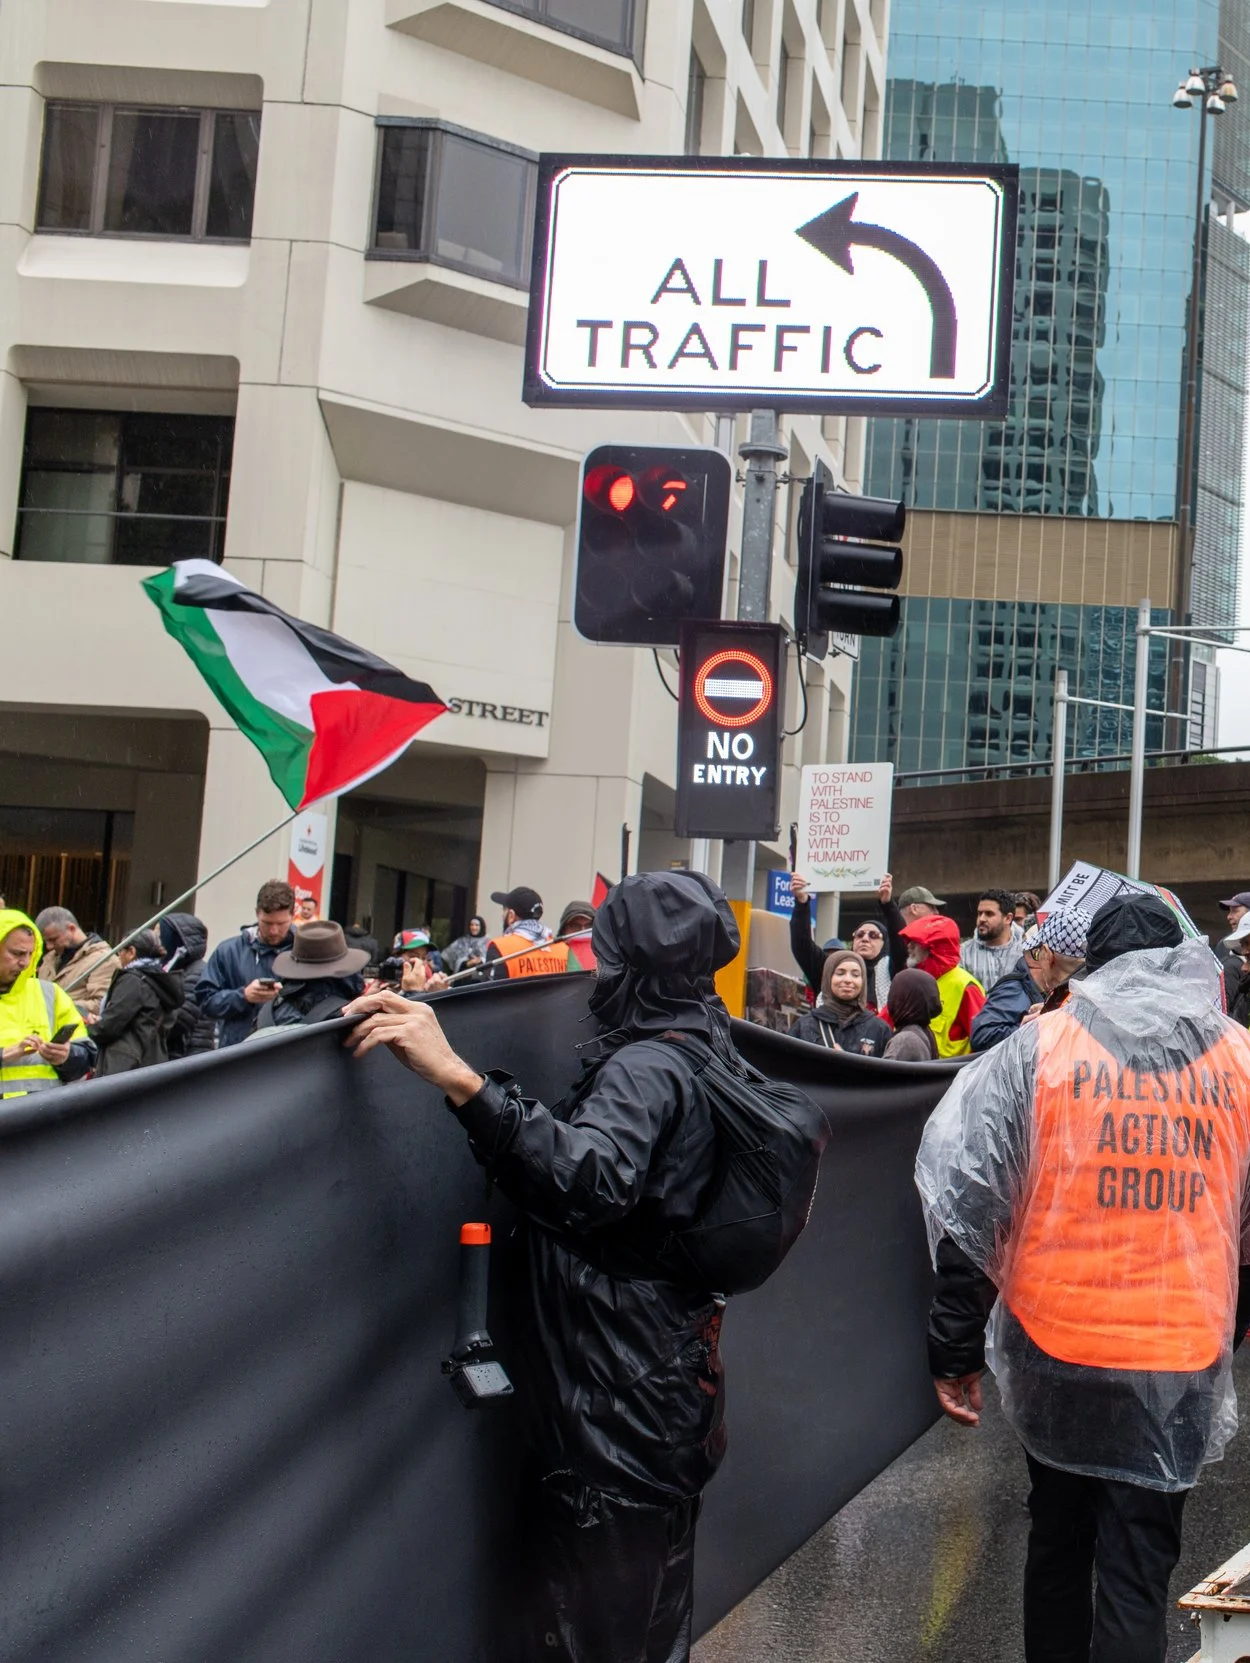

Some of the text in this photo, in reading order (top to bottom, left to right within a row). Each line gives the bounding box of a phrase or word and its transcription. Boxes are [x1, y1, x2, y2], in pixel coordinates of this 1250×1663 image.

[651, 257, 791, 307] ALL
[576, 319, 884, 375] TRAFFIC
[448, 697, 549, 727] STREET
[707, 731, 754, 760] NO
[692, 763, 767, 786] ENTRY
[812, 771, 873, 784] TO STAND
[811, 785, 843, 796] WITH
[810, 797, 874, 810] PALESTINE
[809, 811, 840, 823] IS TO
[808, 824, 850, 836] STAND
[808, 837, 840, 849] WITH
[807, 850, 870, 863] HUMANITY
[775, 876, 790, 892] For
[774, 892, 796, 908] Leas
[1073, 1059, 1236, 1112] PALESTINE
[1097, 1111, 1214, 1161] ACTION
[1097, 1165, 1207, 1213] GROUP
